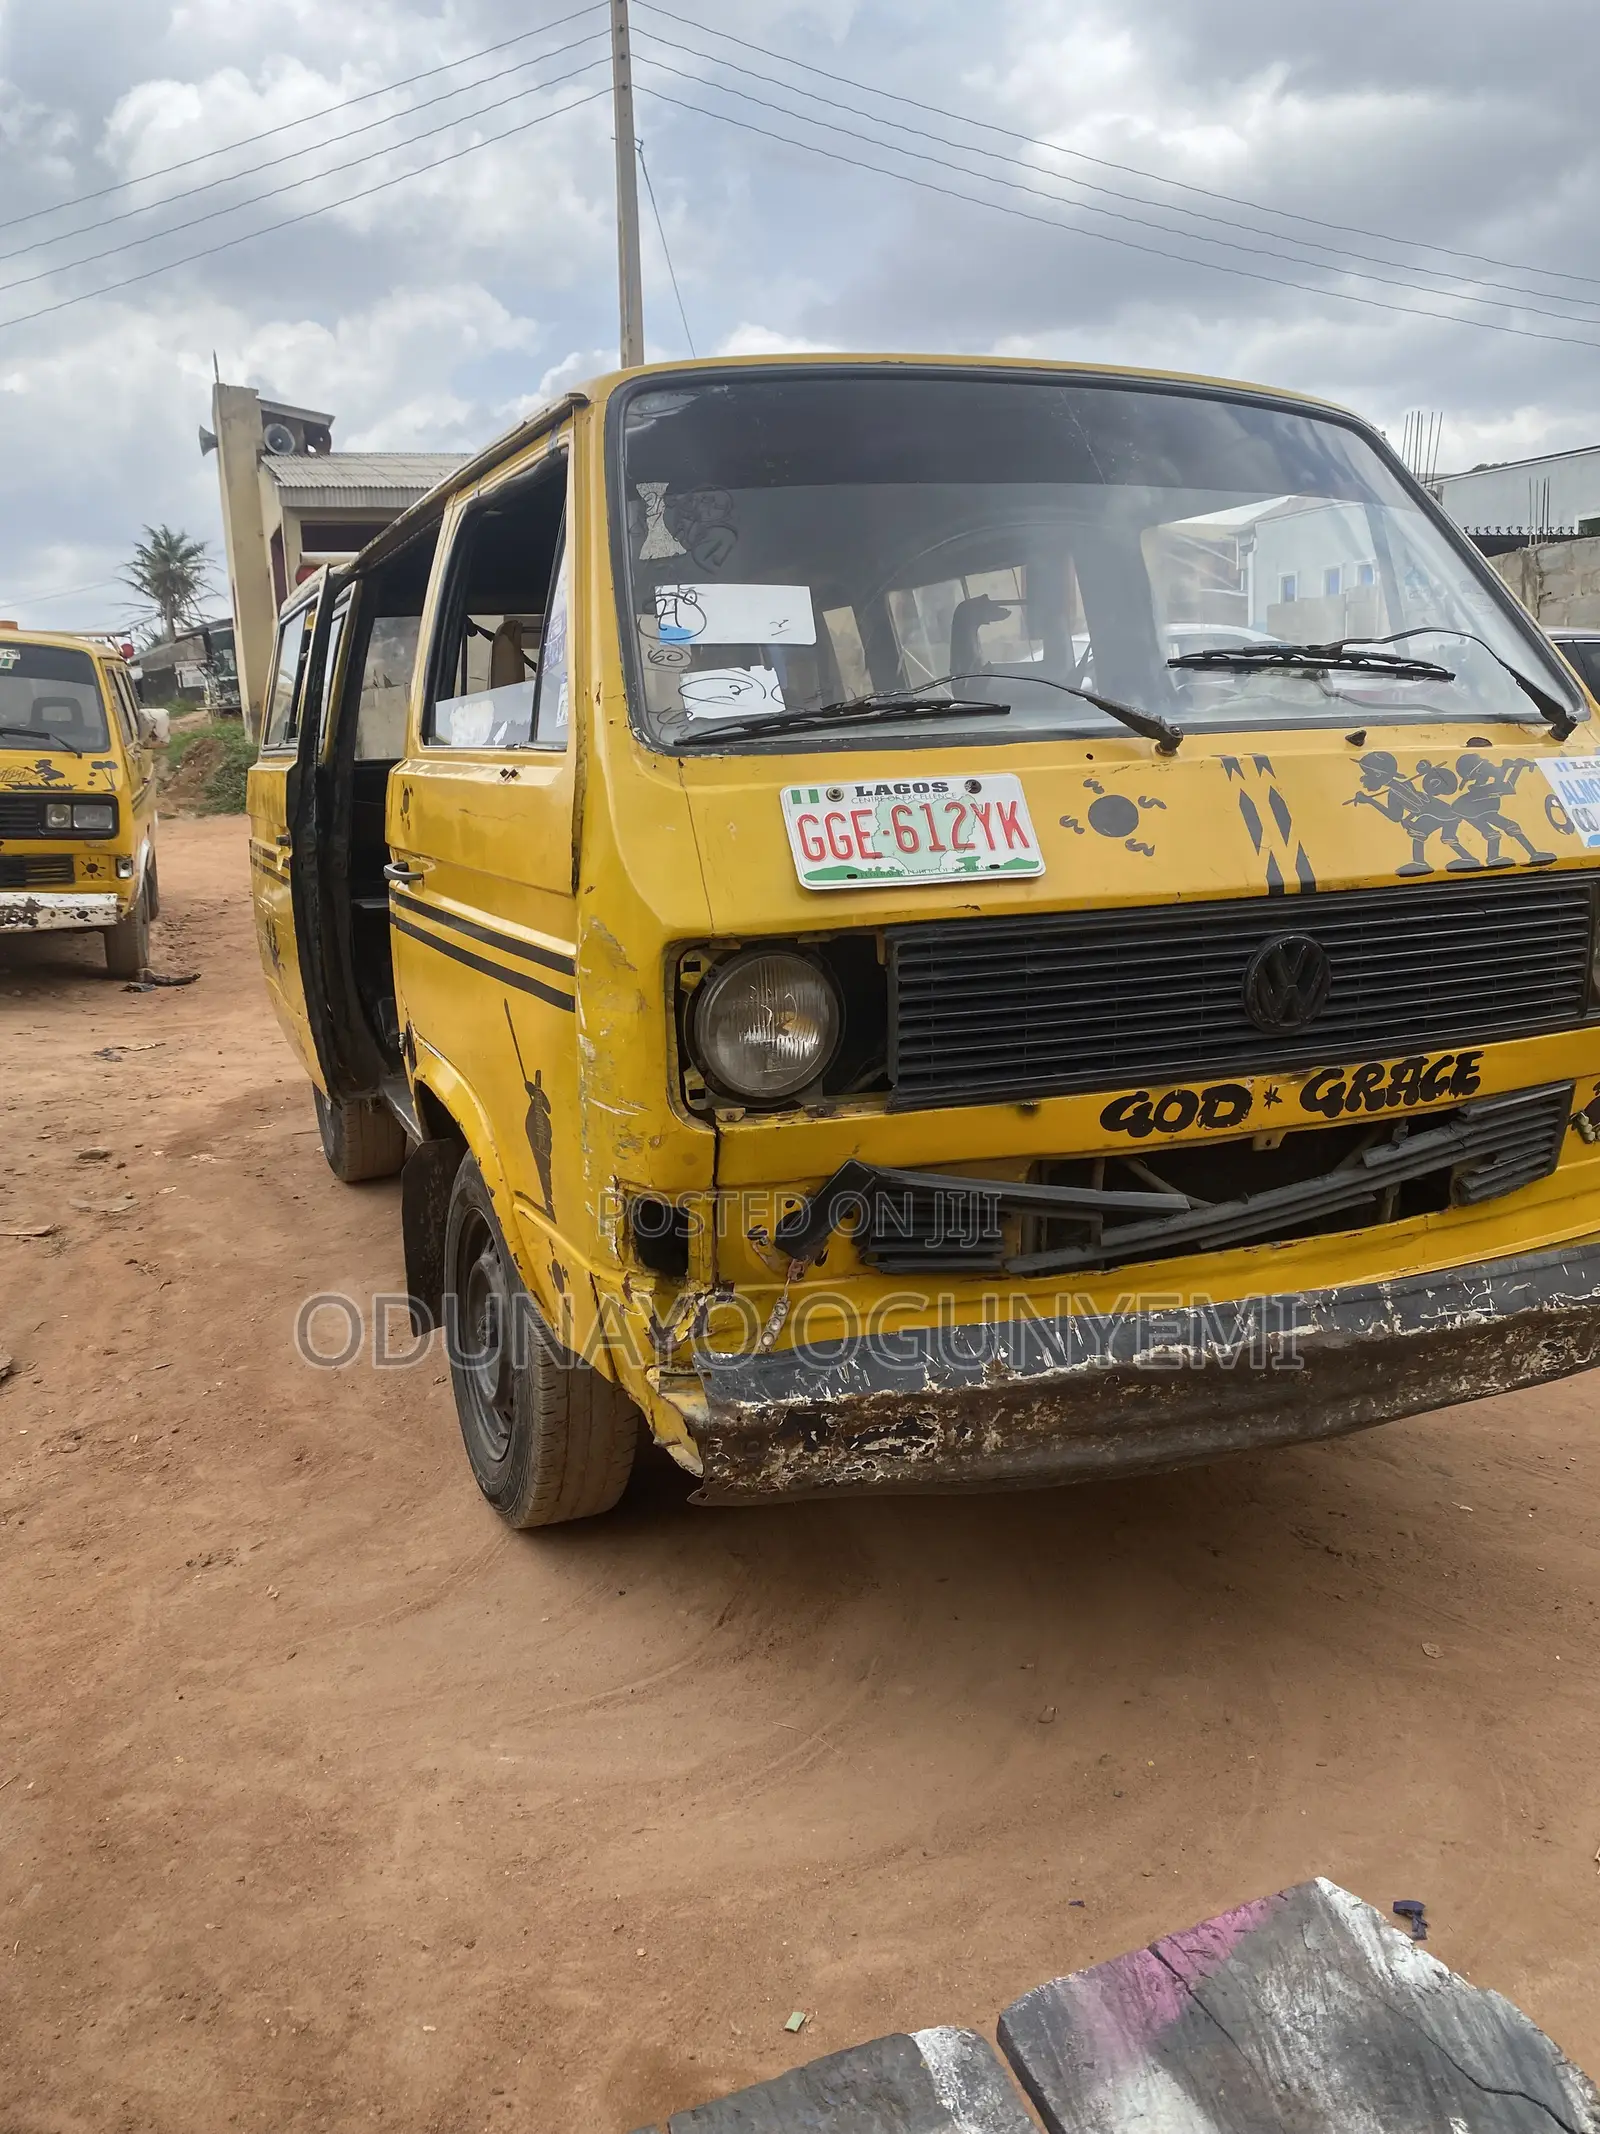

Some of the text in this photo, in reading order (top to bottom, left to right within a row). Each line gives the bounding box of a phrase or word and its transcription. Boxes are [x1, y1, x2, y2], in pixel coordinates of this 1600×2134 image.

[855, 782, 949, 797] LAGOS
[1100, 1050, 1484, 1138] GOD GRACE
